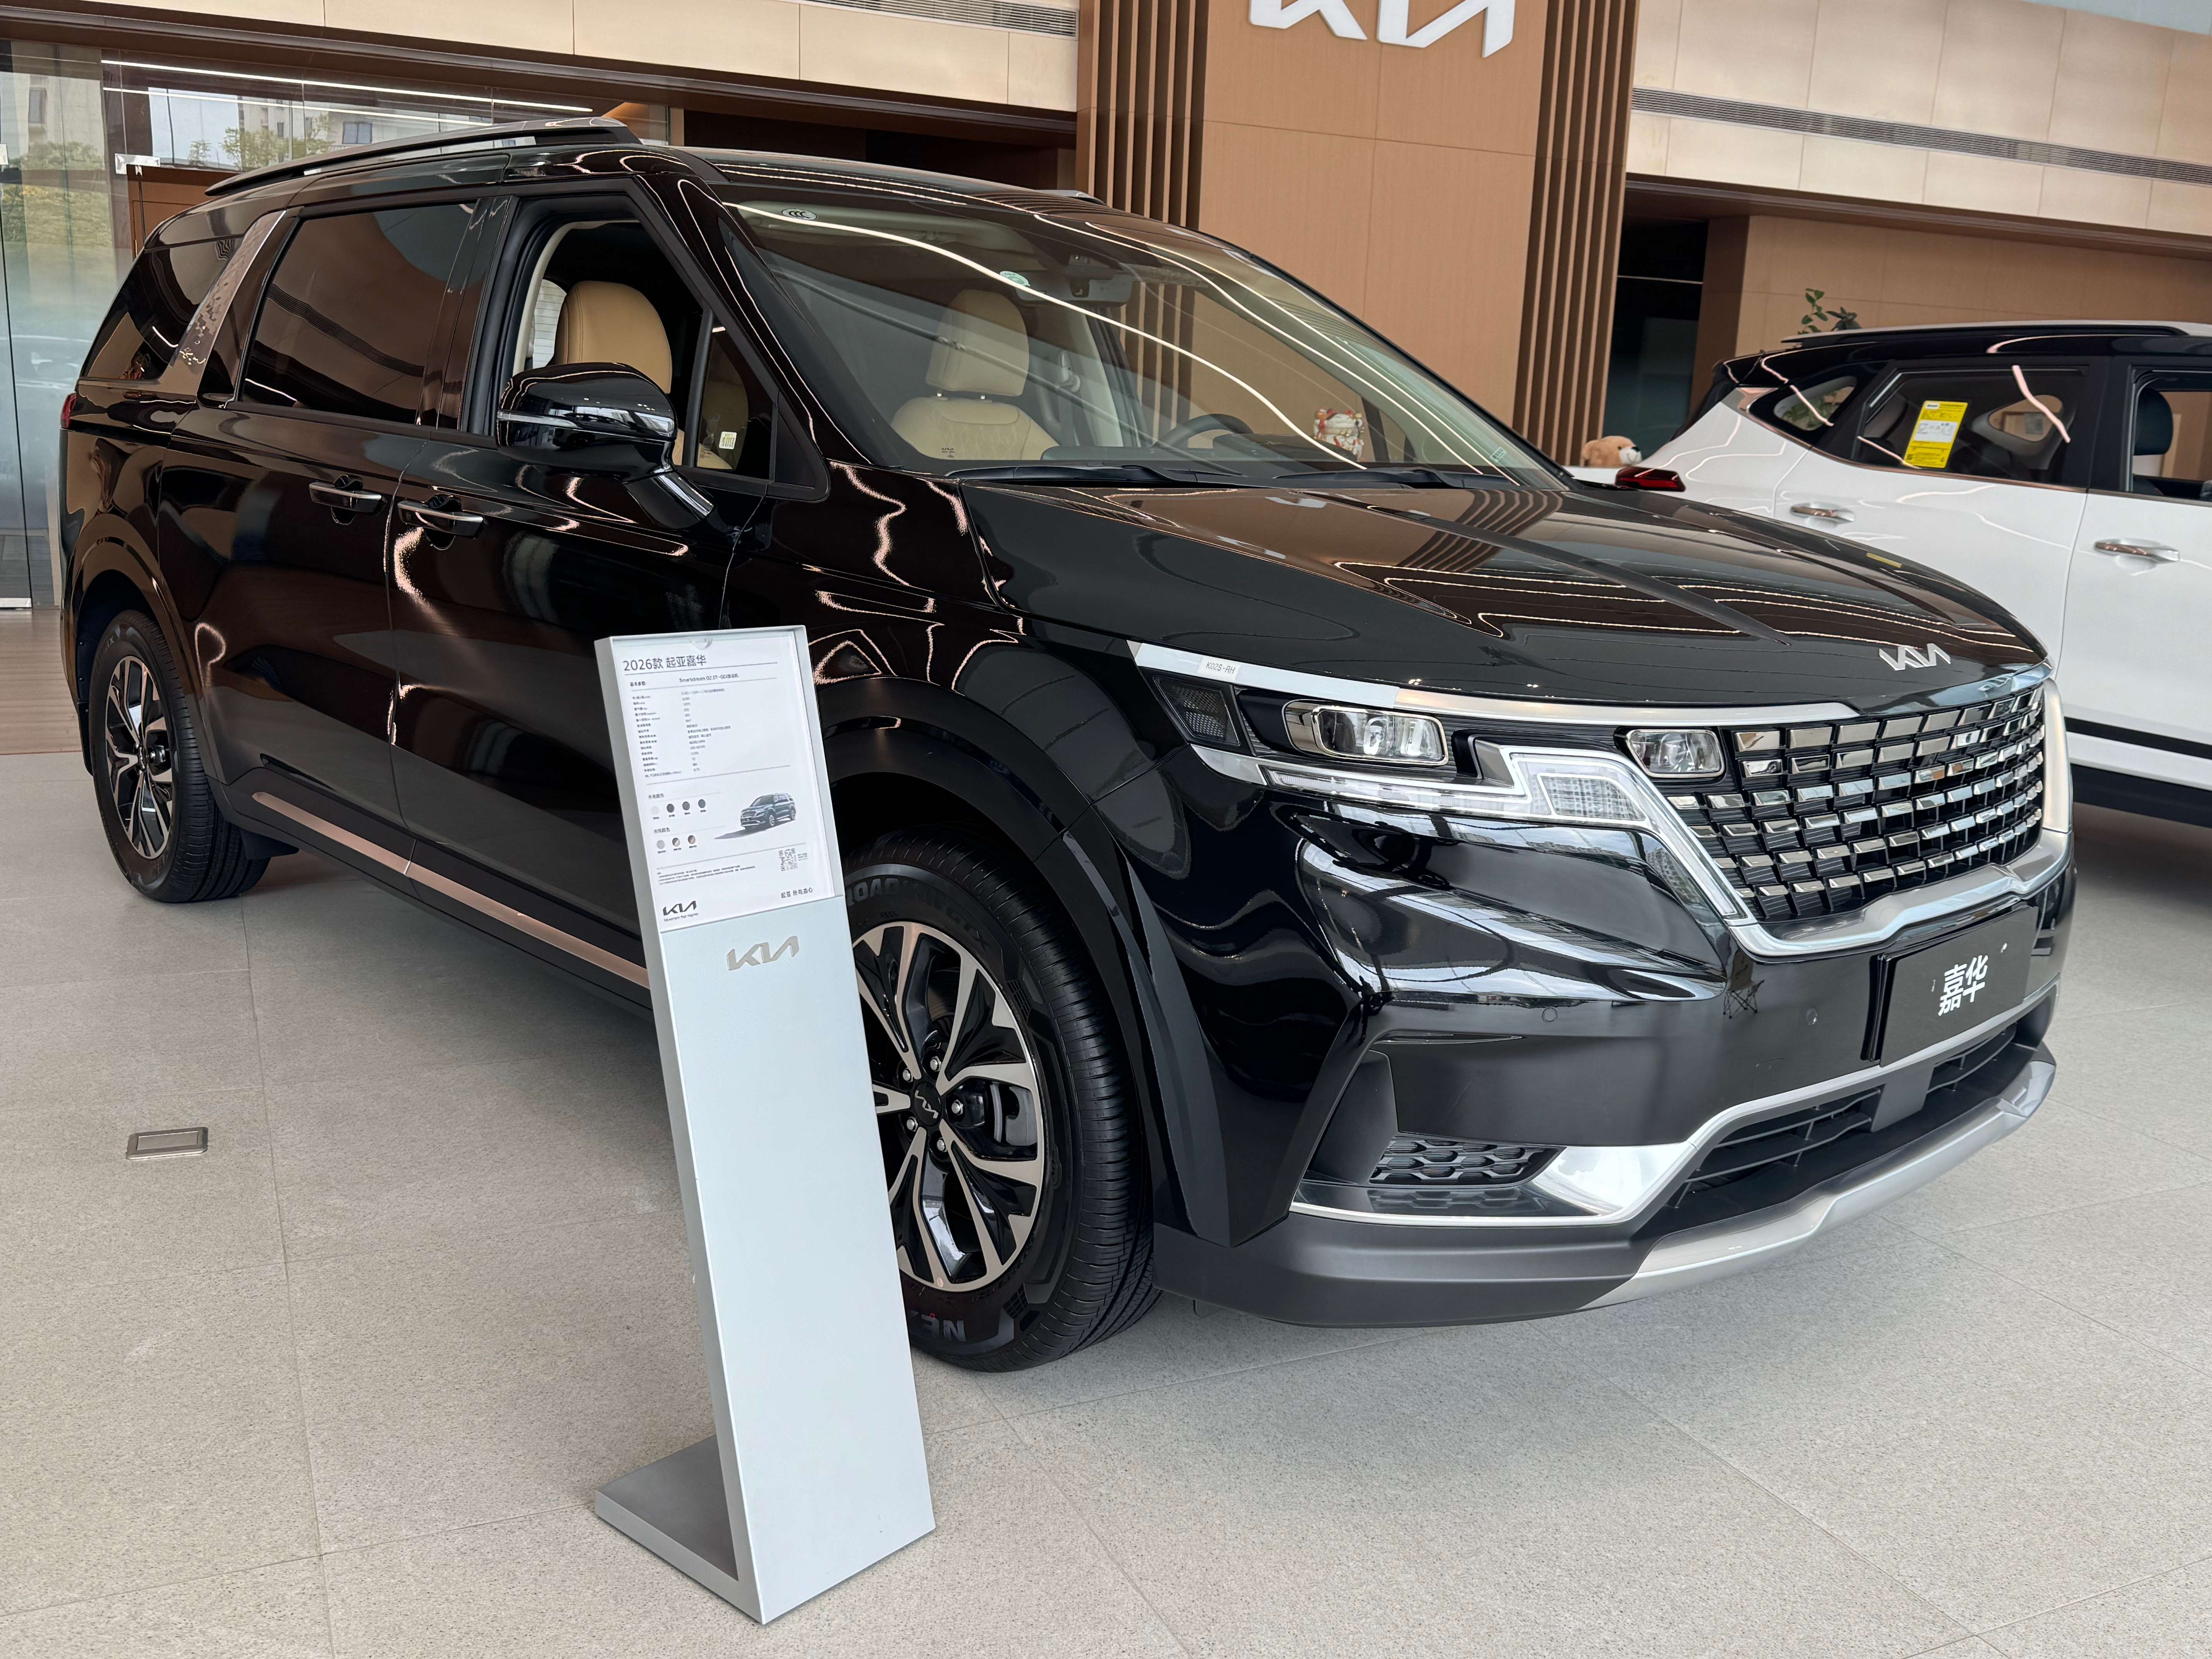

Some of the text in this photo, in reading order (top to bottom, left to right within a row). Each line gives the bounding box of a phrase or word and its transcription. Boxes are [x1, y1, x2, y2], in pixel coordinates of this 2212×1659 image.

[623, 655, 706, 671] 2026款 起亚嘉华
[1206, 662, 1235, 674] K02S-RH
[1879, 643, 1951, 671] KIA
[663, 900, 697, 915] KIA
[726, 936, 799, 970] KIA
[1938, 955, 1988, 1016] 嘉华
